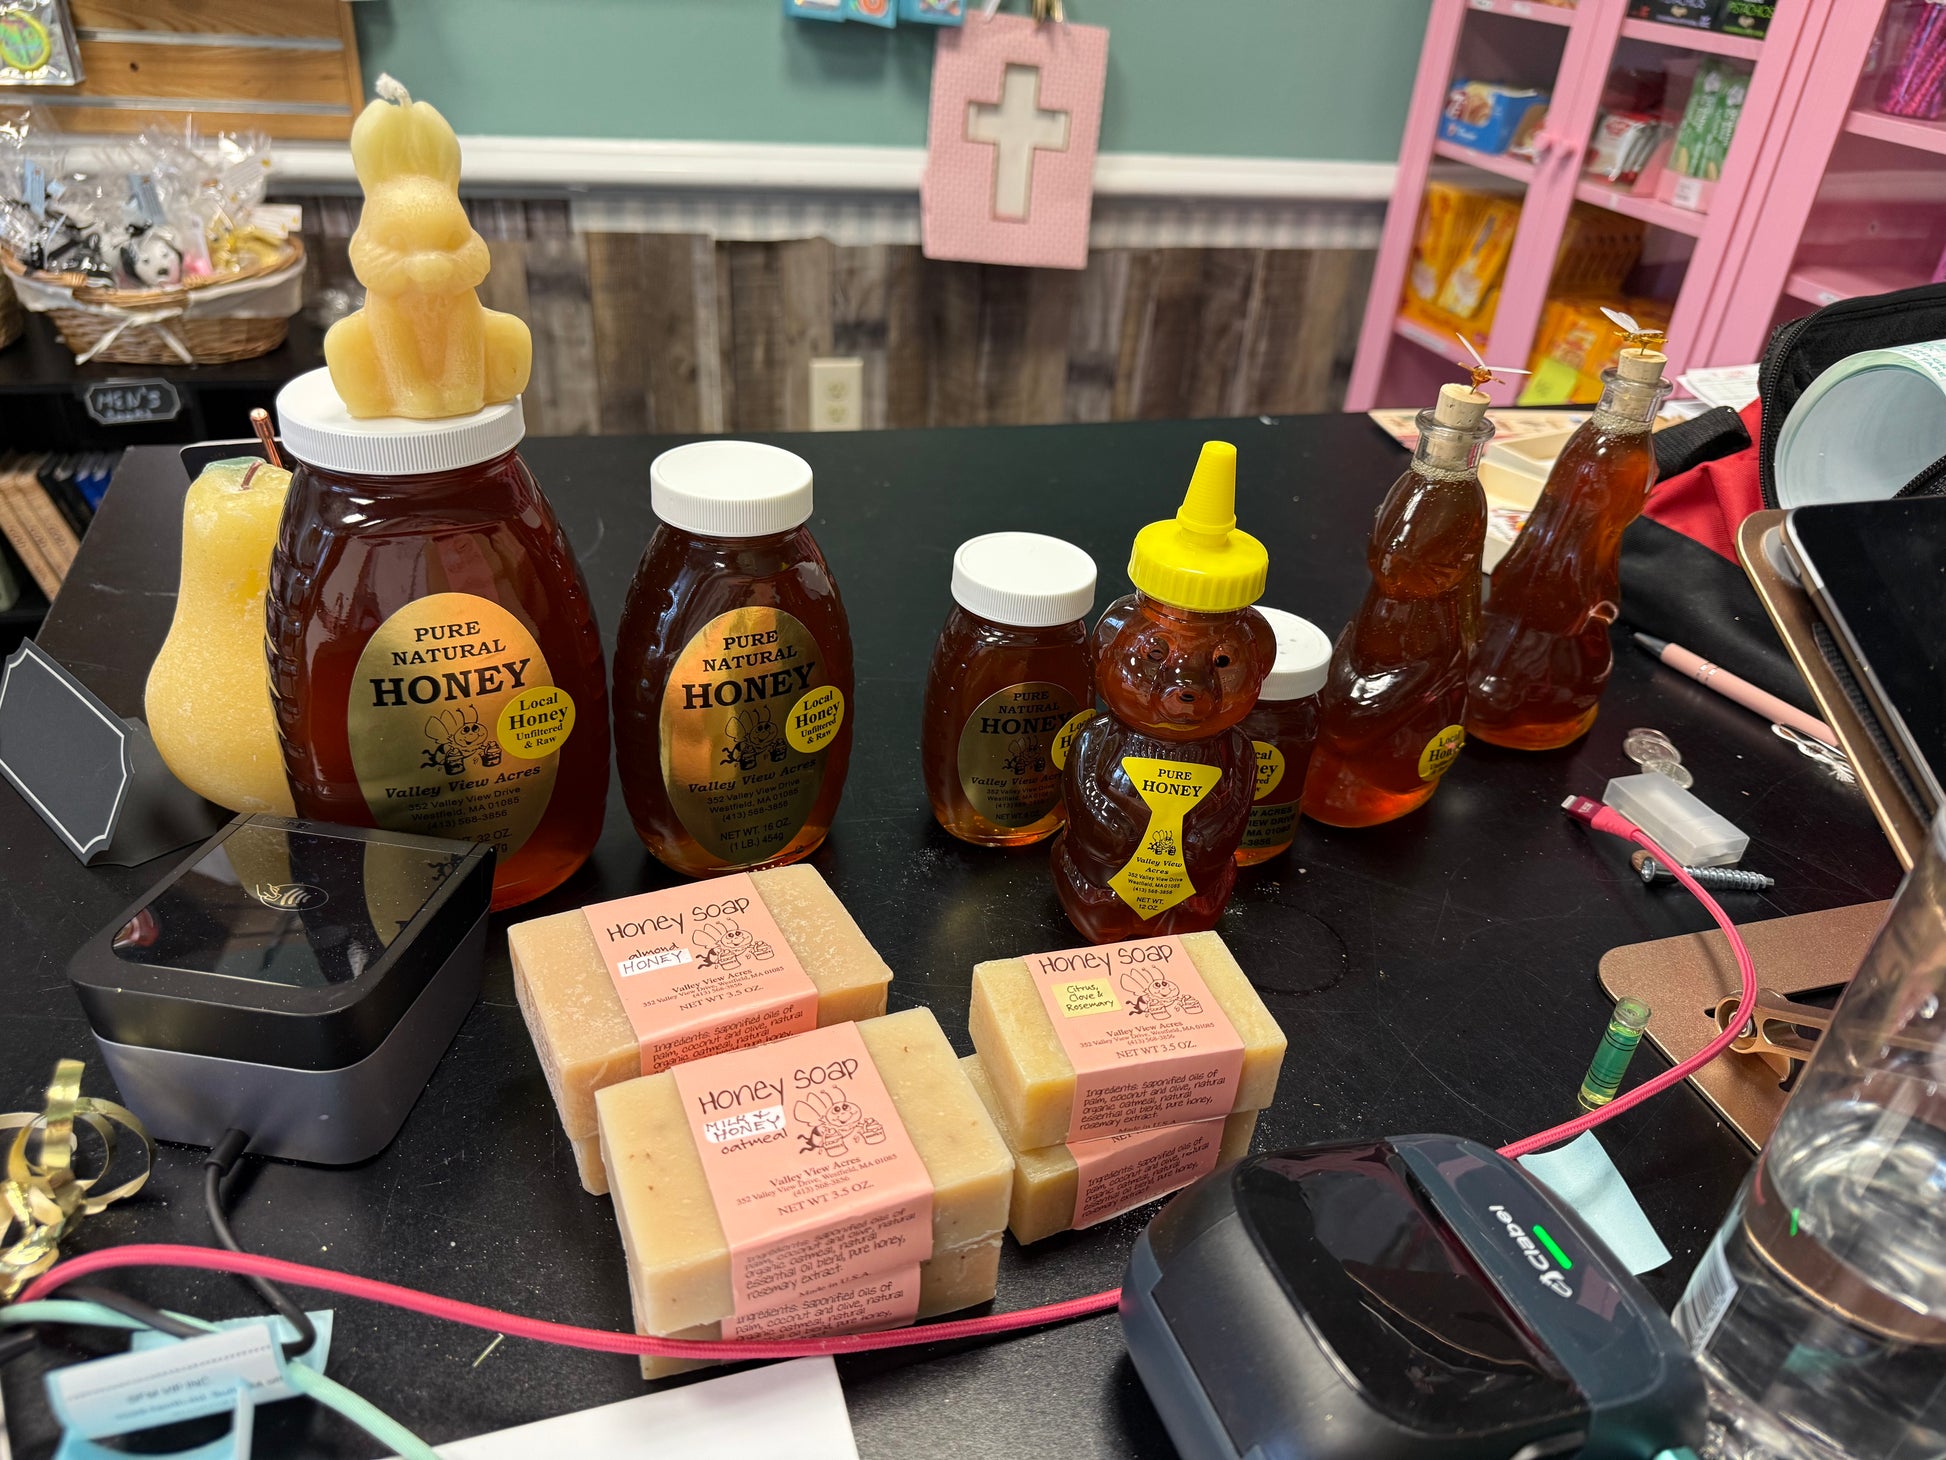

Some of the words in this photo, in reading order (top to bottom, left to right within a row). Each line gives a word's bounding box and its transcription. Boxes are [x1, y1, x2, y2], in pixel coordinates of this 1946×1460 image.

[414, 621, 481, 642] PURE
[723, 630, 778, 650] PURE
[392, 639, 506, 666] NATURAL
[702, 645, 797, 672] NATURAL
[369, 658, 531, 707] HONEY
[682, 661, 816, 709] HONEY
[519, 693, 558, 711] Local
[804, 690, 833, 711] Local
[998, 703, 1059, 714] NATURAL
[1013, 691, 1049, 702] PURE
[508, 706, 568, 730] Honey
[795, 701, 840, 729] Honey
[801, 714, 836, 738] Unfiltered
[980, 711, 1072, 735] HONEY
[516, 723, 563, 741] Unfiltered
[524, 740, 534, 749] &
[536, 735, 557, 747] Raw
[807, 736, 814, 744] &
[816, 729, 831, 741] Raw
[1255, 750, 1272, 760] cal
[385, 785, 441, 799] Valley
[448, 778, 489, 792] View
[495, 766, 541, 784] Acres
[688, 780, 736, 793] Valley
[742, 771, 776, 785] View
[780, 759, 817, 777] Acres
[971, 776, 1007, 787] Valley
[1012, 776, 1037, 785] View
[1158, 768, 1192, 781] PURE
[408, 802, 428, 811] 352
[431, 798, 464, 809] Valley
[466, 792, 491, 803] View
[494, 786, 520, 797] Drive
[707, 796, 724, 805] 352
[726, 791, 754, 802] Valley
[755, 786, 776, 796] View
[778, 779, 800, 790] Drive
[1142, 780, 1203, 797] HONEY
[411, 808, 466, 821] Westfield,
[469, 804, 485, 813] MA
[488, 796, 520, 809] 01085
[709, 801, 755, 814] Westfield,
[757, 796, 771, 805] MA
[773, 788, 799, 800] 01085
[722, 811, 746, 823] (413)
[747, 801, 788, 816] 568-3856
[1260, 806, 1292, 817] ACRES
[427, 819, 456, 830] (413)
[458, 810, 507, 827] 568-3856
[720, 830, 740, 841] NET
[742, 825, 760, 836] WT.
[763, 822, 774, 831] 16
[729, 842, 738, 853] (1
[741, 837, 760, 849] LB.)
[762, 832, 784, 843] 454g
[1136, 856, 1160, 867] Valley
[1163, 860, 1183, 868] View
[1145, 867, 1169, 875] Acres
[606, 913, 683, 942] Honey
[623, 950, 682, 974] HONEY
[628, 942, 679, 960] almond
[1039, 952, 1111, 976] Honey
[657, 995, 678, 1005] Valley
[679, 988, 696, 997] View
[751, 970, 764, 979] MA
[765, 965, 785, 975] 01085
[672, 982, 700, 994] Valley
[702, 975, 725, 986] View
[728, 968, 753, 979] Acres
[1066, 983, 1099, 995] Citrus,
[679, 1000, 703, 1011] NET
[705, 994, 725, 1005] WT
[728, 990, 742, 999] 3.5
[1066, 999, 1114, 1012] Rosemary
[1069, 992, 1095, 1002] Clove
[1097, 990, 1103, 998] &
[1080, 1041, 1092, 1049] 352
[1092, 1038, 1113, 1048] Valley
[1115, 1035, 1130, 1044] View
[1182, 1024, 1195, 1032] MA
[1106, 1026, 1133, 1038] Valley
[1135, 1024, 1157, 1033] View
[1159, 1020, 1183, 1030] Acres
[1116, 1048, 1139, 1059] NET
[1140, 1045, 1159, 1056] WT
[1161, 1043, 1176, 1052] 3.5
[1177, 1039, 1197, 1049] OZ.
[698, 1077, 784, 1114] Honey
[1083, 1096, 1108, 1108] palm,
[1110, 1090, 1147, 1103] coconut
[1150, 1086, 1167, 1096] and
[1169, 1083, 1191, 1093] olive,
[1194, 1077, 1226, 1089] natural
[1086, 1083, 1136, 1098] Ingredients:
[1142, 1075, 1186, 1090] saponified
[1189, 1073, 1205, 1082] oils
[1207, 1069, 1218, 1079] of
[1081, 1110, 1123, 1123] essential
[1125, 1106, 1136, 1116] oil
[1139, 1103, 1163, 1115] blend,
[1166, 1099, 1183, 1110] pure
[1186, 1095, 1213, 1107] honey,
[1082, 1103, 1115, 1116] organic
[1119, 1096, 1158, 1109] oatmeal,
[1160, 1090, 1192, 1102] natural
[706, 1114, 747, 1132] MILK
[714, 1115, 780, 1142] HONEY
[721, 1127, 788, 1155] oatmeal
[736, 1197, 752, 1206] 352
[752, 1189, 776, 1201] Valley
[777, 1183, 797, 1194] View
[859, 1160, 874, 1171] MA
[769, 1173, 802, 1188] Valley
[804, 1164, 831, 1177] View
[833, 1156, 862, 1171] Acres
[777, 1201, 805, 1216] NET
[808, 1192, 829, 1207] WT
[832, 1186, 850, 1200] 3.5
